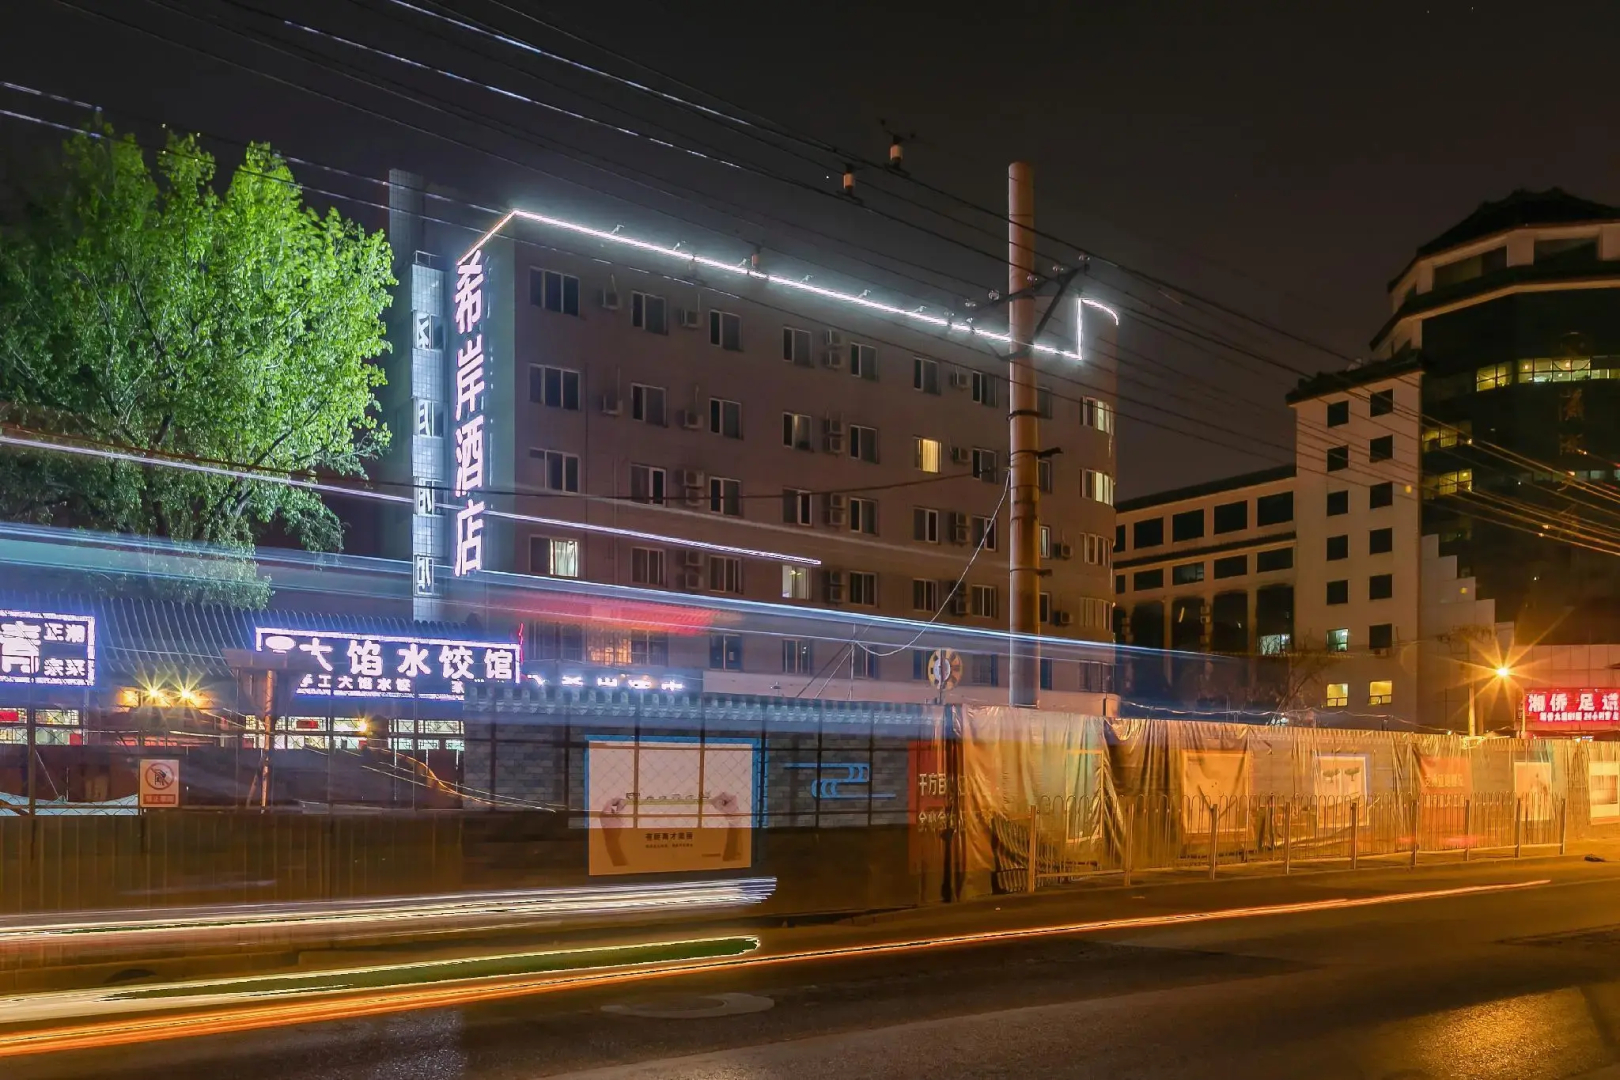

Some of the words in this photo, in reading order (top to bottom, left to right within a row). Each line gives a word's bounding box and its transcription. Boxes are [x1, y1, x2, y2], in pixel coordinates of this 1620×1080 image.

[453, 249, 486, 577] 希岸酒店
[299, 637, 513, 680] 大馅水饺馆
